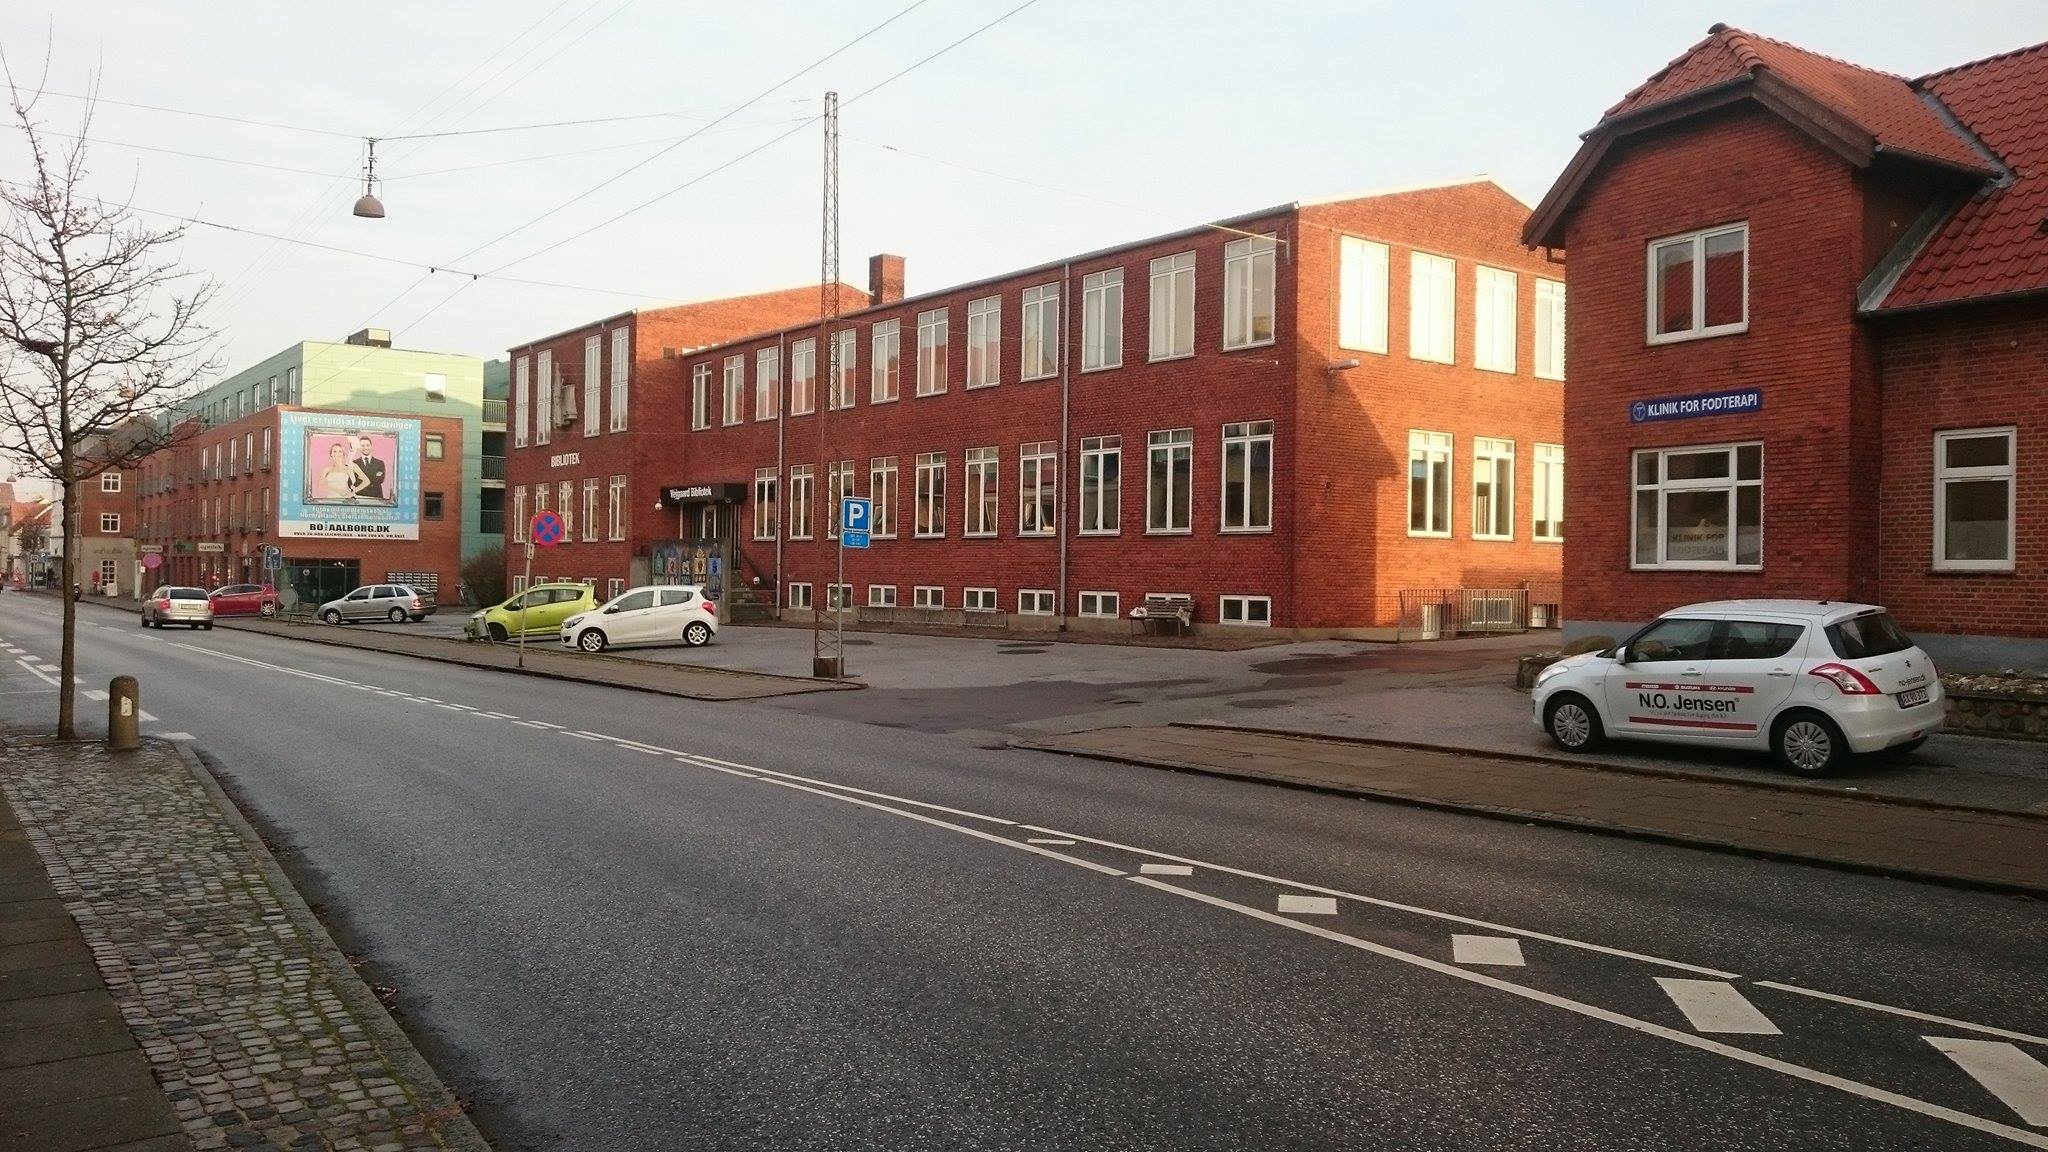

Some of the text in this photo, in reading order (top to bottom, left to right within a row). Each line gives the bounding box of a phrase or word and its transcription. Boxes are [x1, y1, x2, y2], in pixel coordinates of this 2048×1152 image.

[1648, 393, 1758, 416] KLINIK FOR FODTERAPI
[551, 452, 580, 468] BIBLIOTEK
[670, 486, 712, 500] Vejgaard Bibliotek
[849, 503, 864, 527] P
[1639, 693, 1670, 709] N.O.
